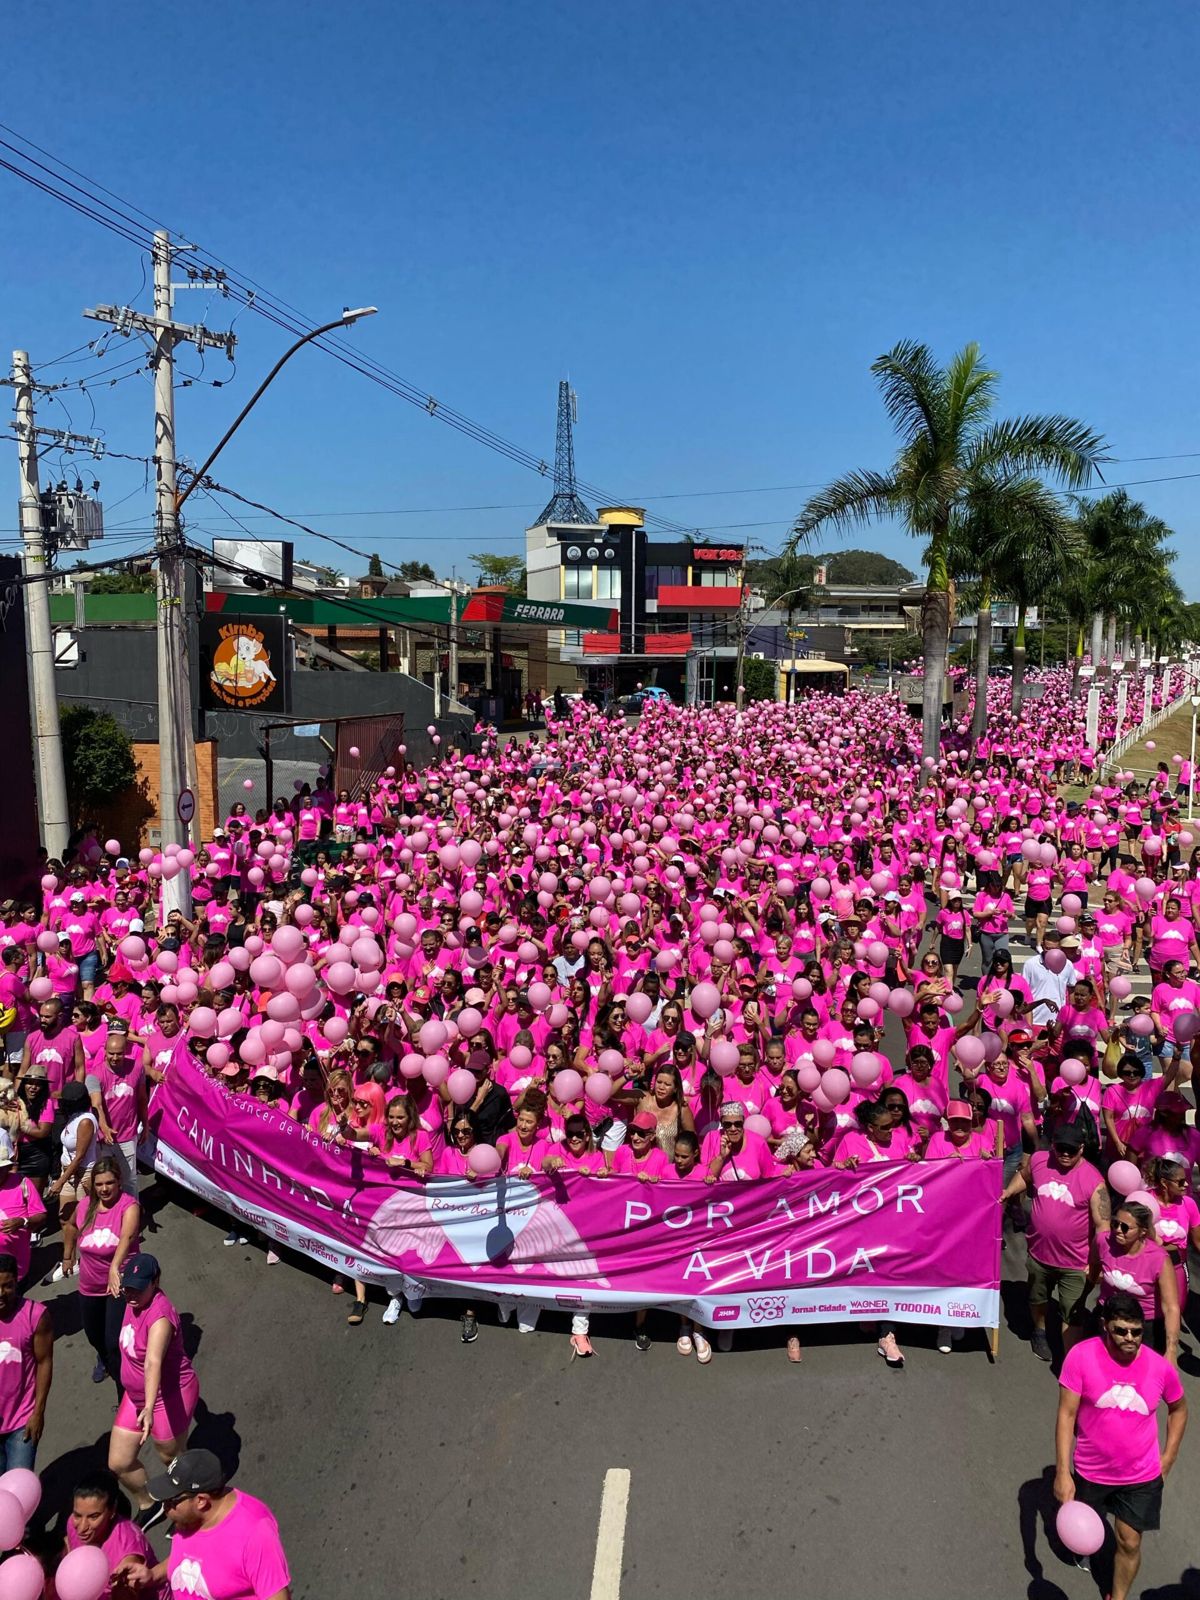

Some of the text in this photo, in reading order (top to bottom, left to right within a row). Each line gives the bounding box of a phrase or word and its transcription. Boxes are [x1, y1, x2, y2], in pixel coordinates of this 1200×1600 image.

[515, 604, 565, 621] FERRARA
[279, 1120, 293, 1135] de
[176, 1106, 360, 1225] CAMINHADA
[431, 1198, 468, 1212] Rosa
[470, 1204, 492, 1216] do
[624, 1184, 925, 1229] POR AMOR
[742, 1247, 876, 1280] VIDA
[747, 1296, 786, 1310] VOX
[850, 1300, 888, 1308] WAGNER
[947, 1301, 976, 1311] GRUPO
[947, 1309, 981, 1319] LIBERAL
